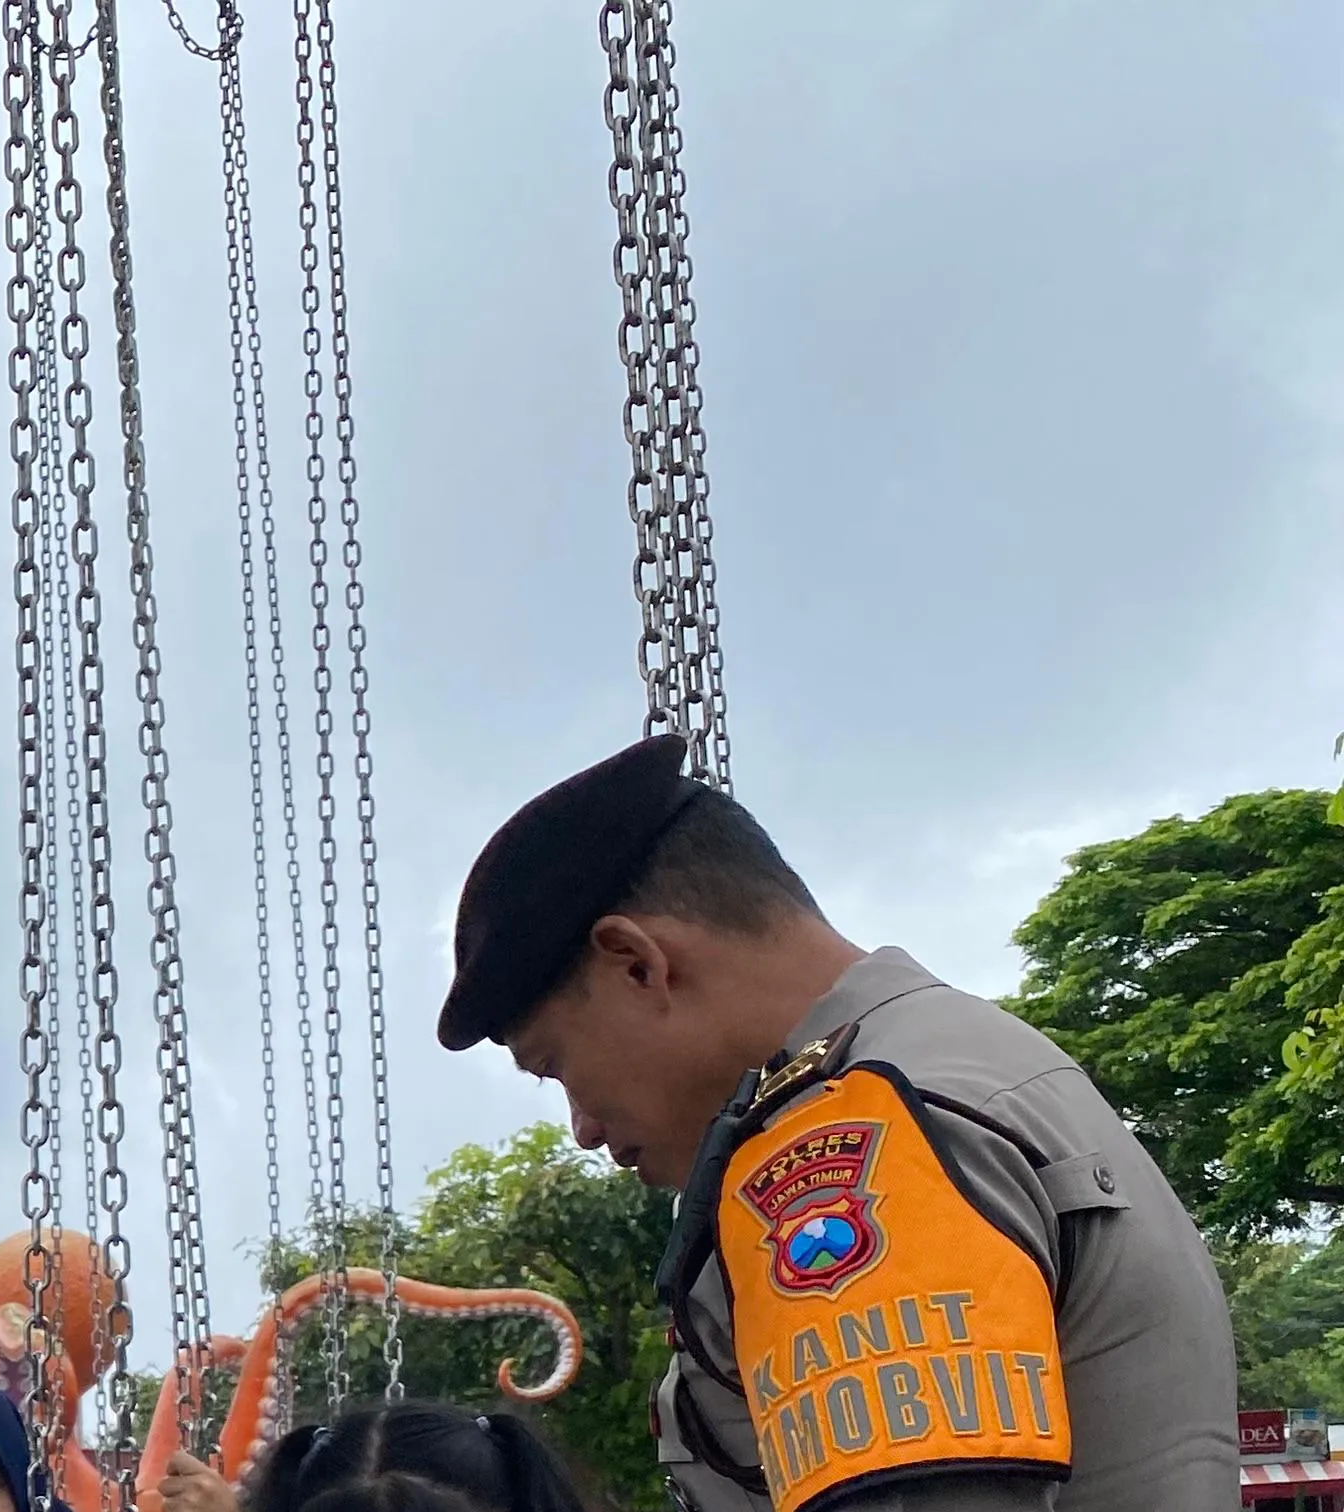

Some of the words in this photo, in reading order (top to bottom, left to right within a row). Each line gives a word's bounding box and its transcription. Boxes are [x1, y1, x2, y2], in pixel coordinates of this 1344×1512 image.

[770, 1179, 807, 1210] JAWA
[808, 1168, 853, 1186] TIMUR
[751, 1289, 975, 1416] KANIT
